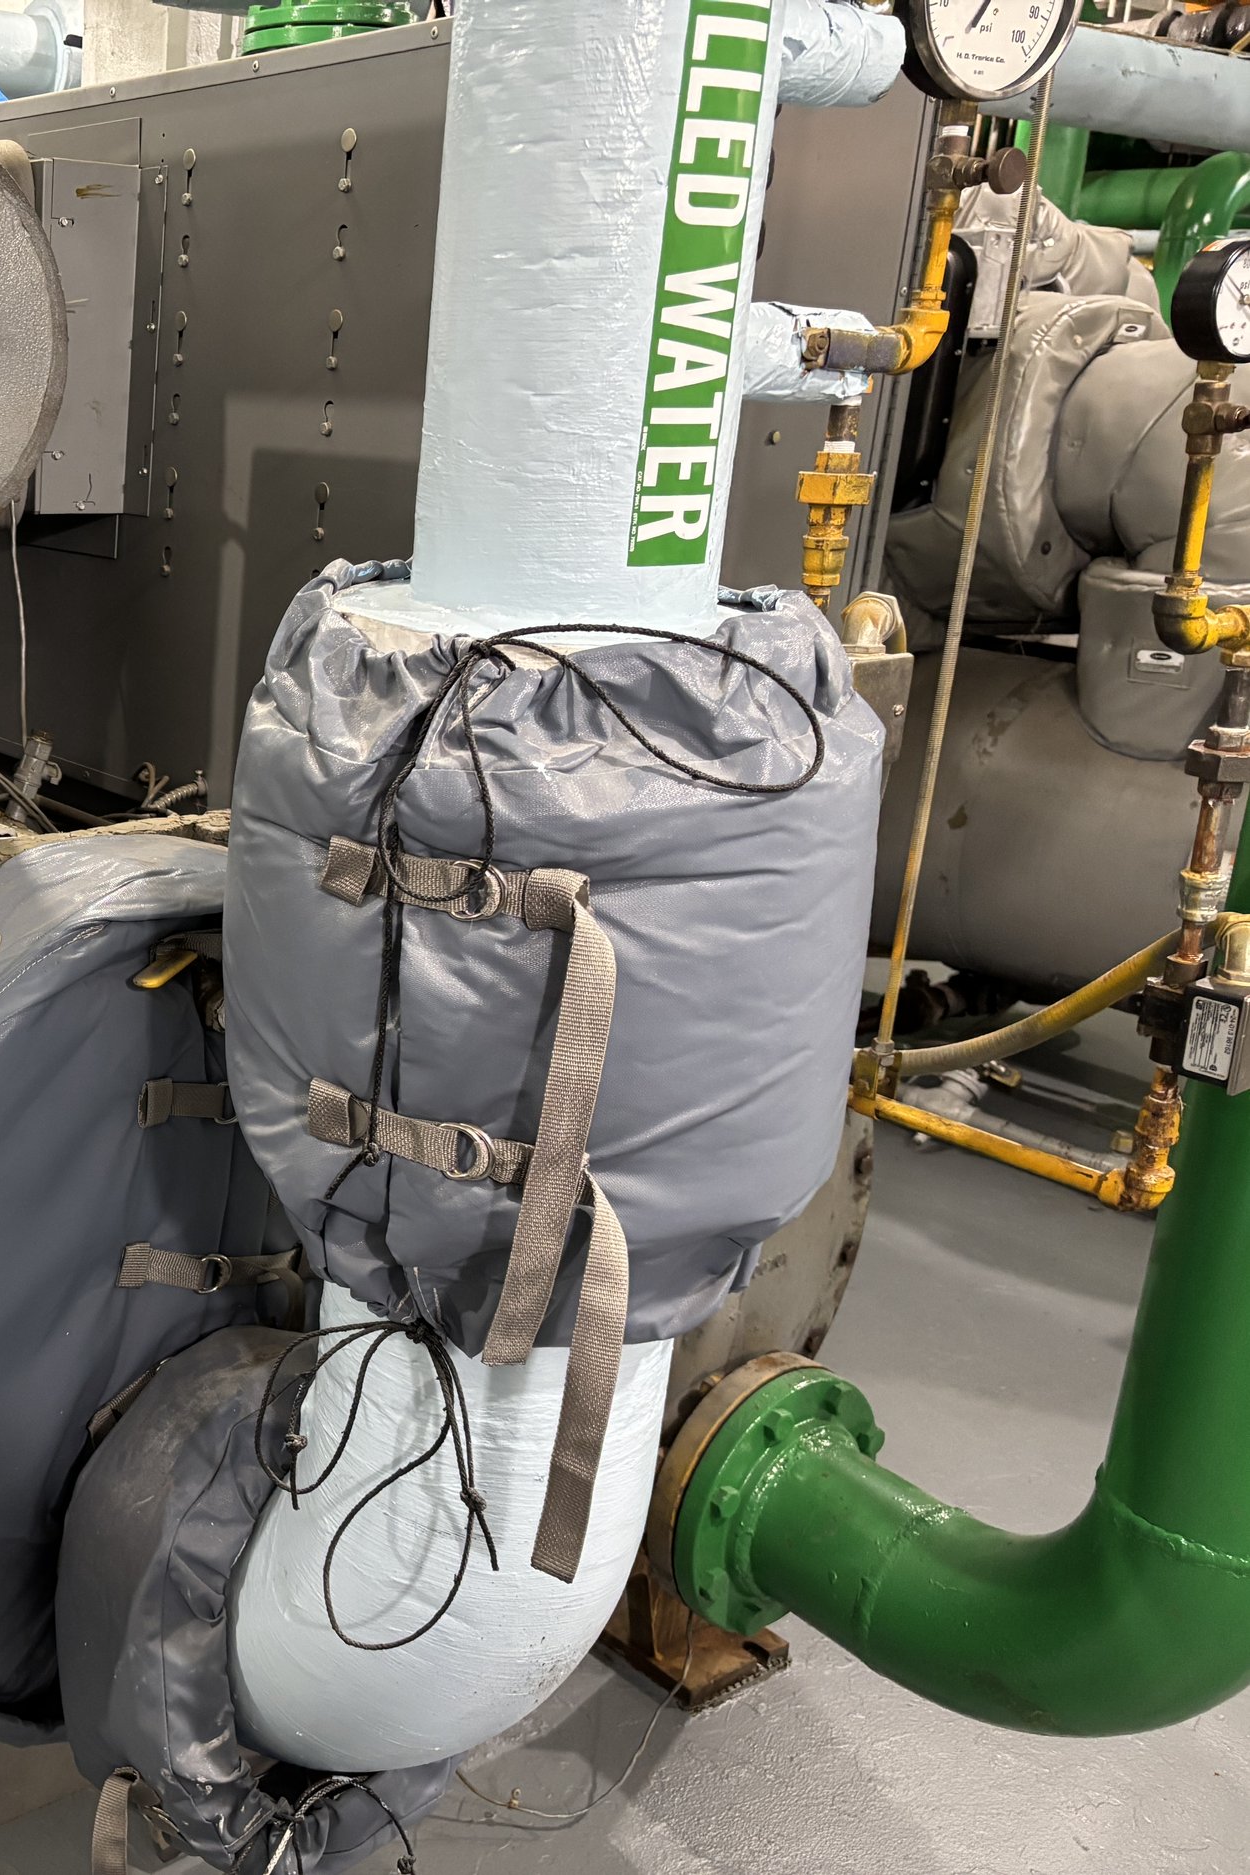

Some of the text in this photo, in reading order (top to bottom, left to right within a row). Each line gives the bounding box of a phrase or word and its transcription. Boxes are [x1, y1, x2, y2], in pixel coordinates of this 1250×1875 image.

[1029, 6, 1039, 19] 90
[980, 23, 993, 33] psi
[1012, 30, 1026, 44] 100
[636, 261, 740, 543] WATER
